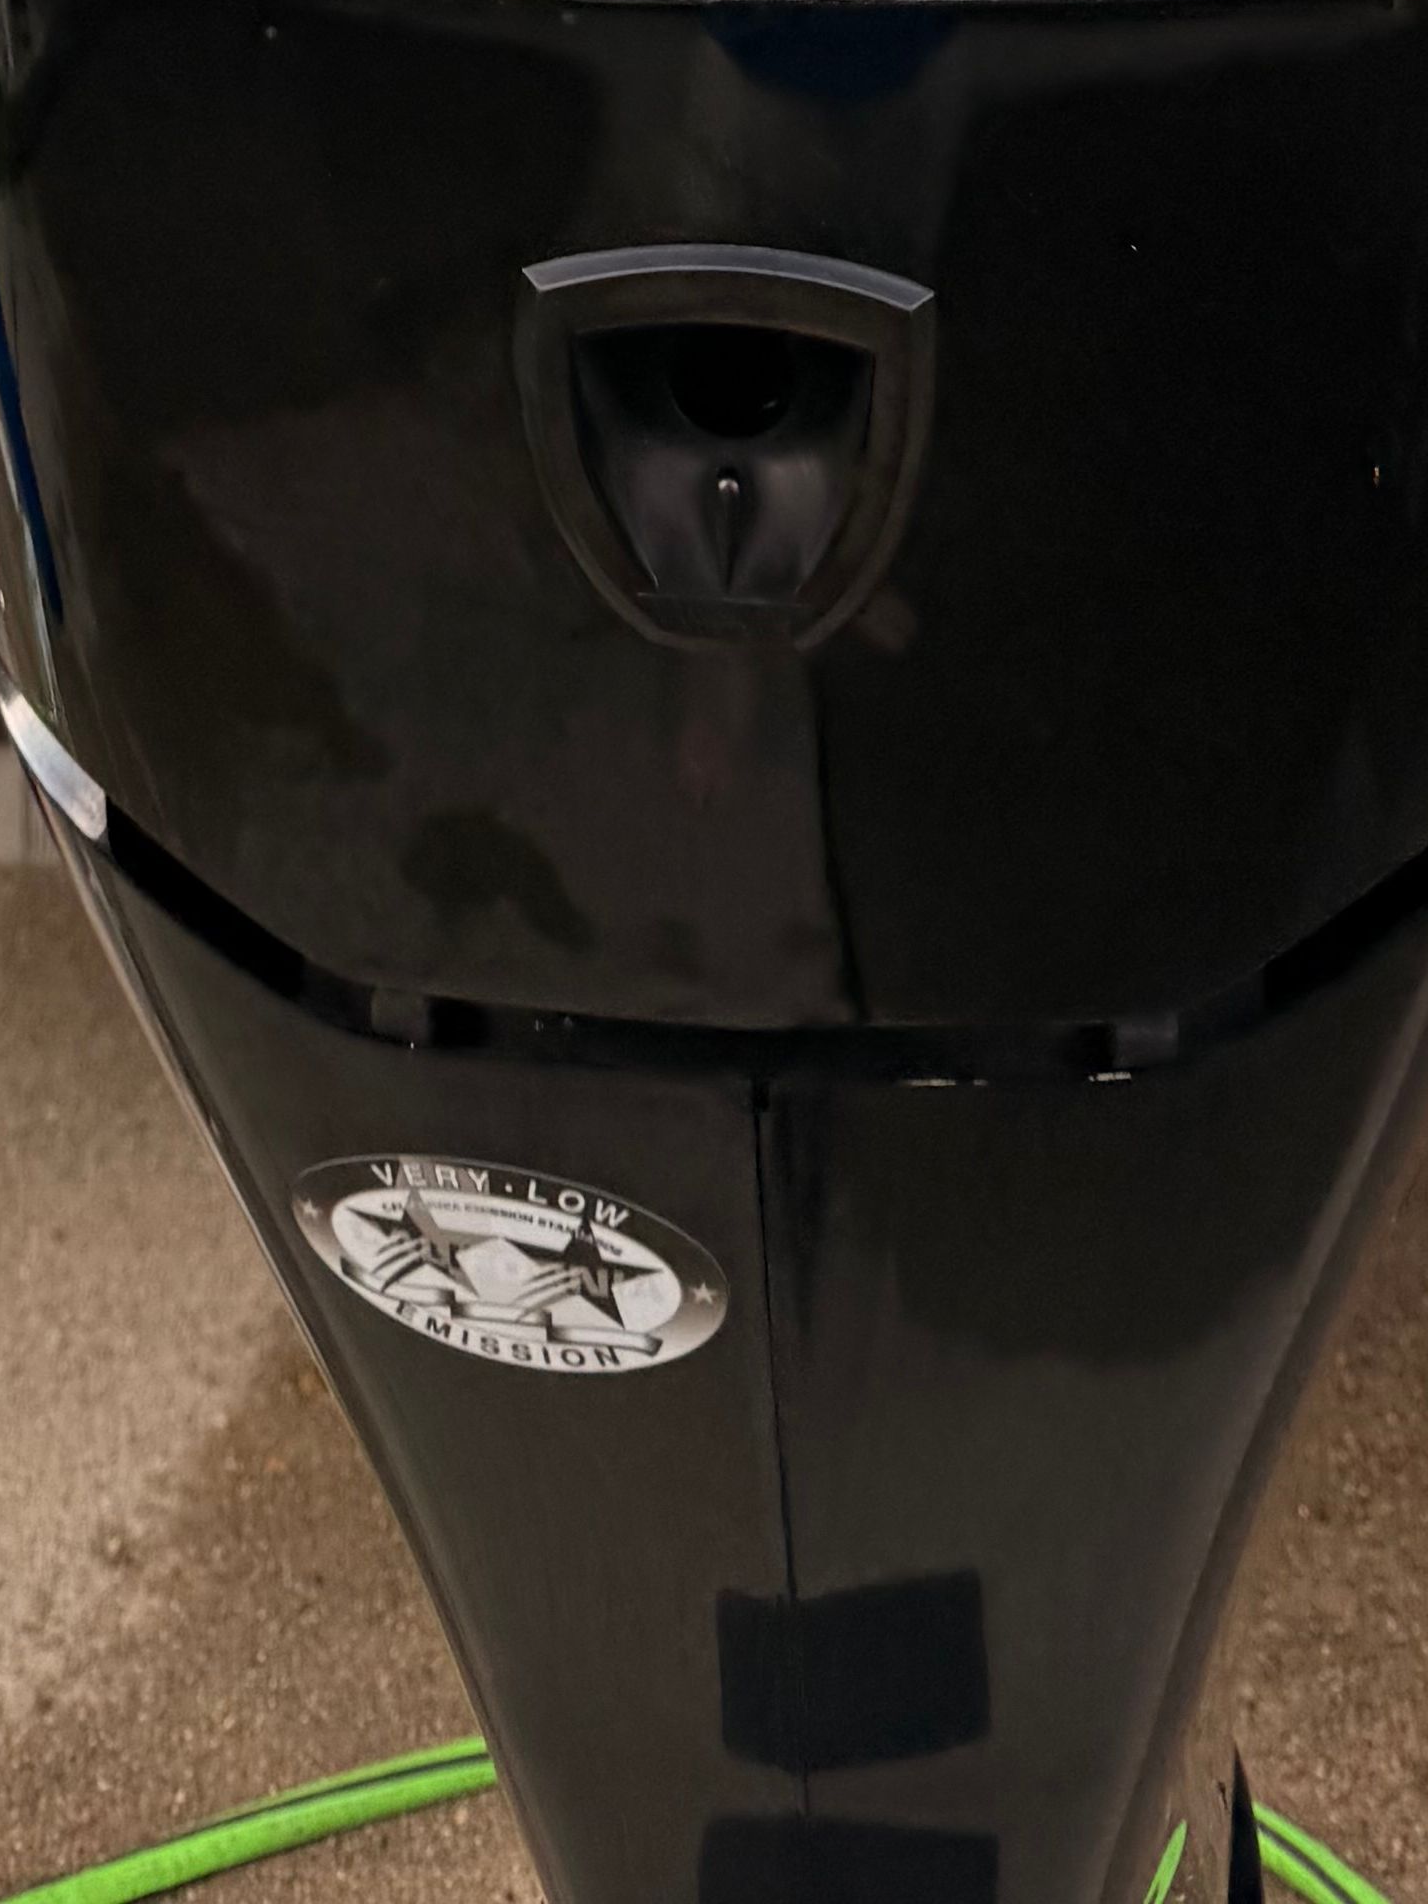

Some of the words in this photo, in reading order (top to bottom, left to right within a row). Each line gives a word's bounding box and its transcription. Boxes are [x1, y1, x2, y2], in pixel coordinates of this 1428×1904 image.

[370, 1158, 491, 1193] VERY
[527, 1178, 630, 1228] LOW
[396, 1299, 623, 1369] EMISSION
